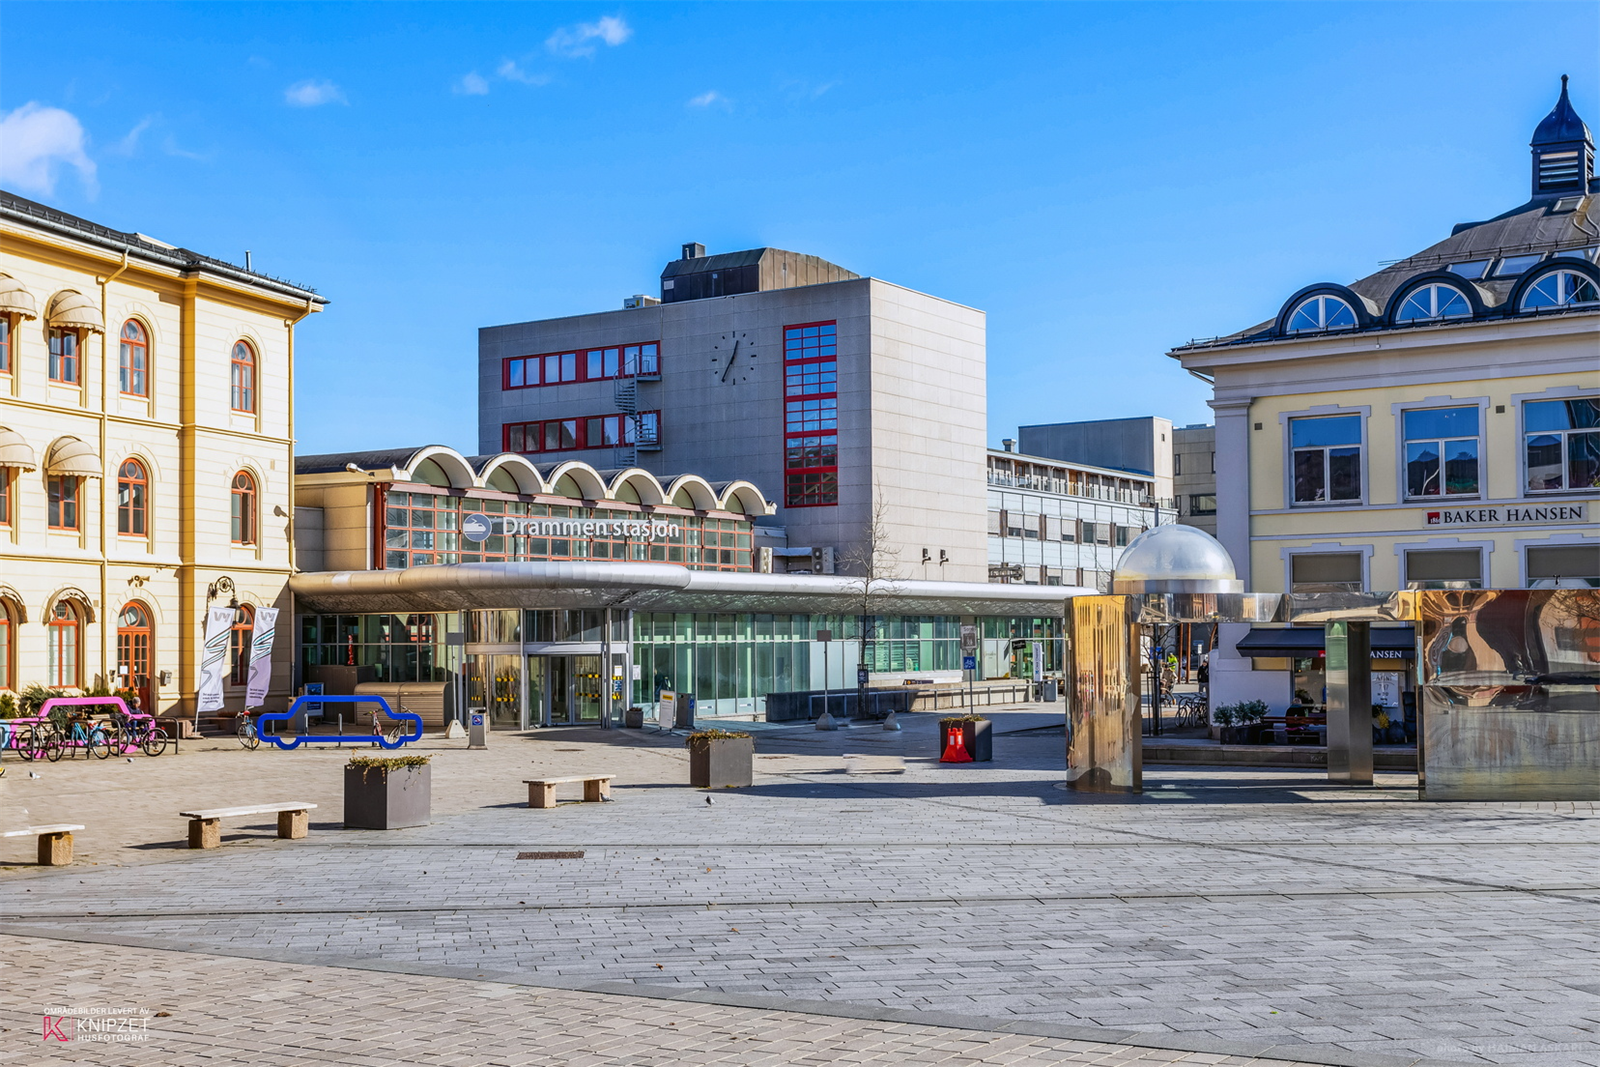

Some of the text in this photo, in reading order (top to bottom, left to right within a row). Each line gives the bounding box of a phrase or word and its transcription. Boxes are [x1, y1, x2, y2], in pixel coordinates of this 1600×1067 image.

[1443, 509, 1500, 523] BAKER
[1506, 506, 1583, 522] HANSEN
[502, 517, 679, 541] Drammen stasjon
[1370, 650, 1402, 659] ANSEN
